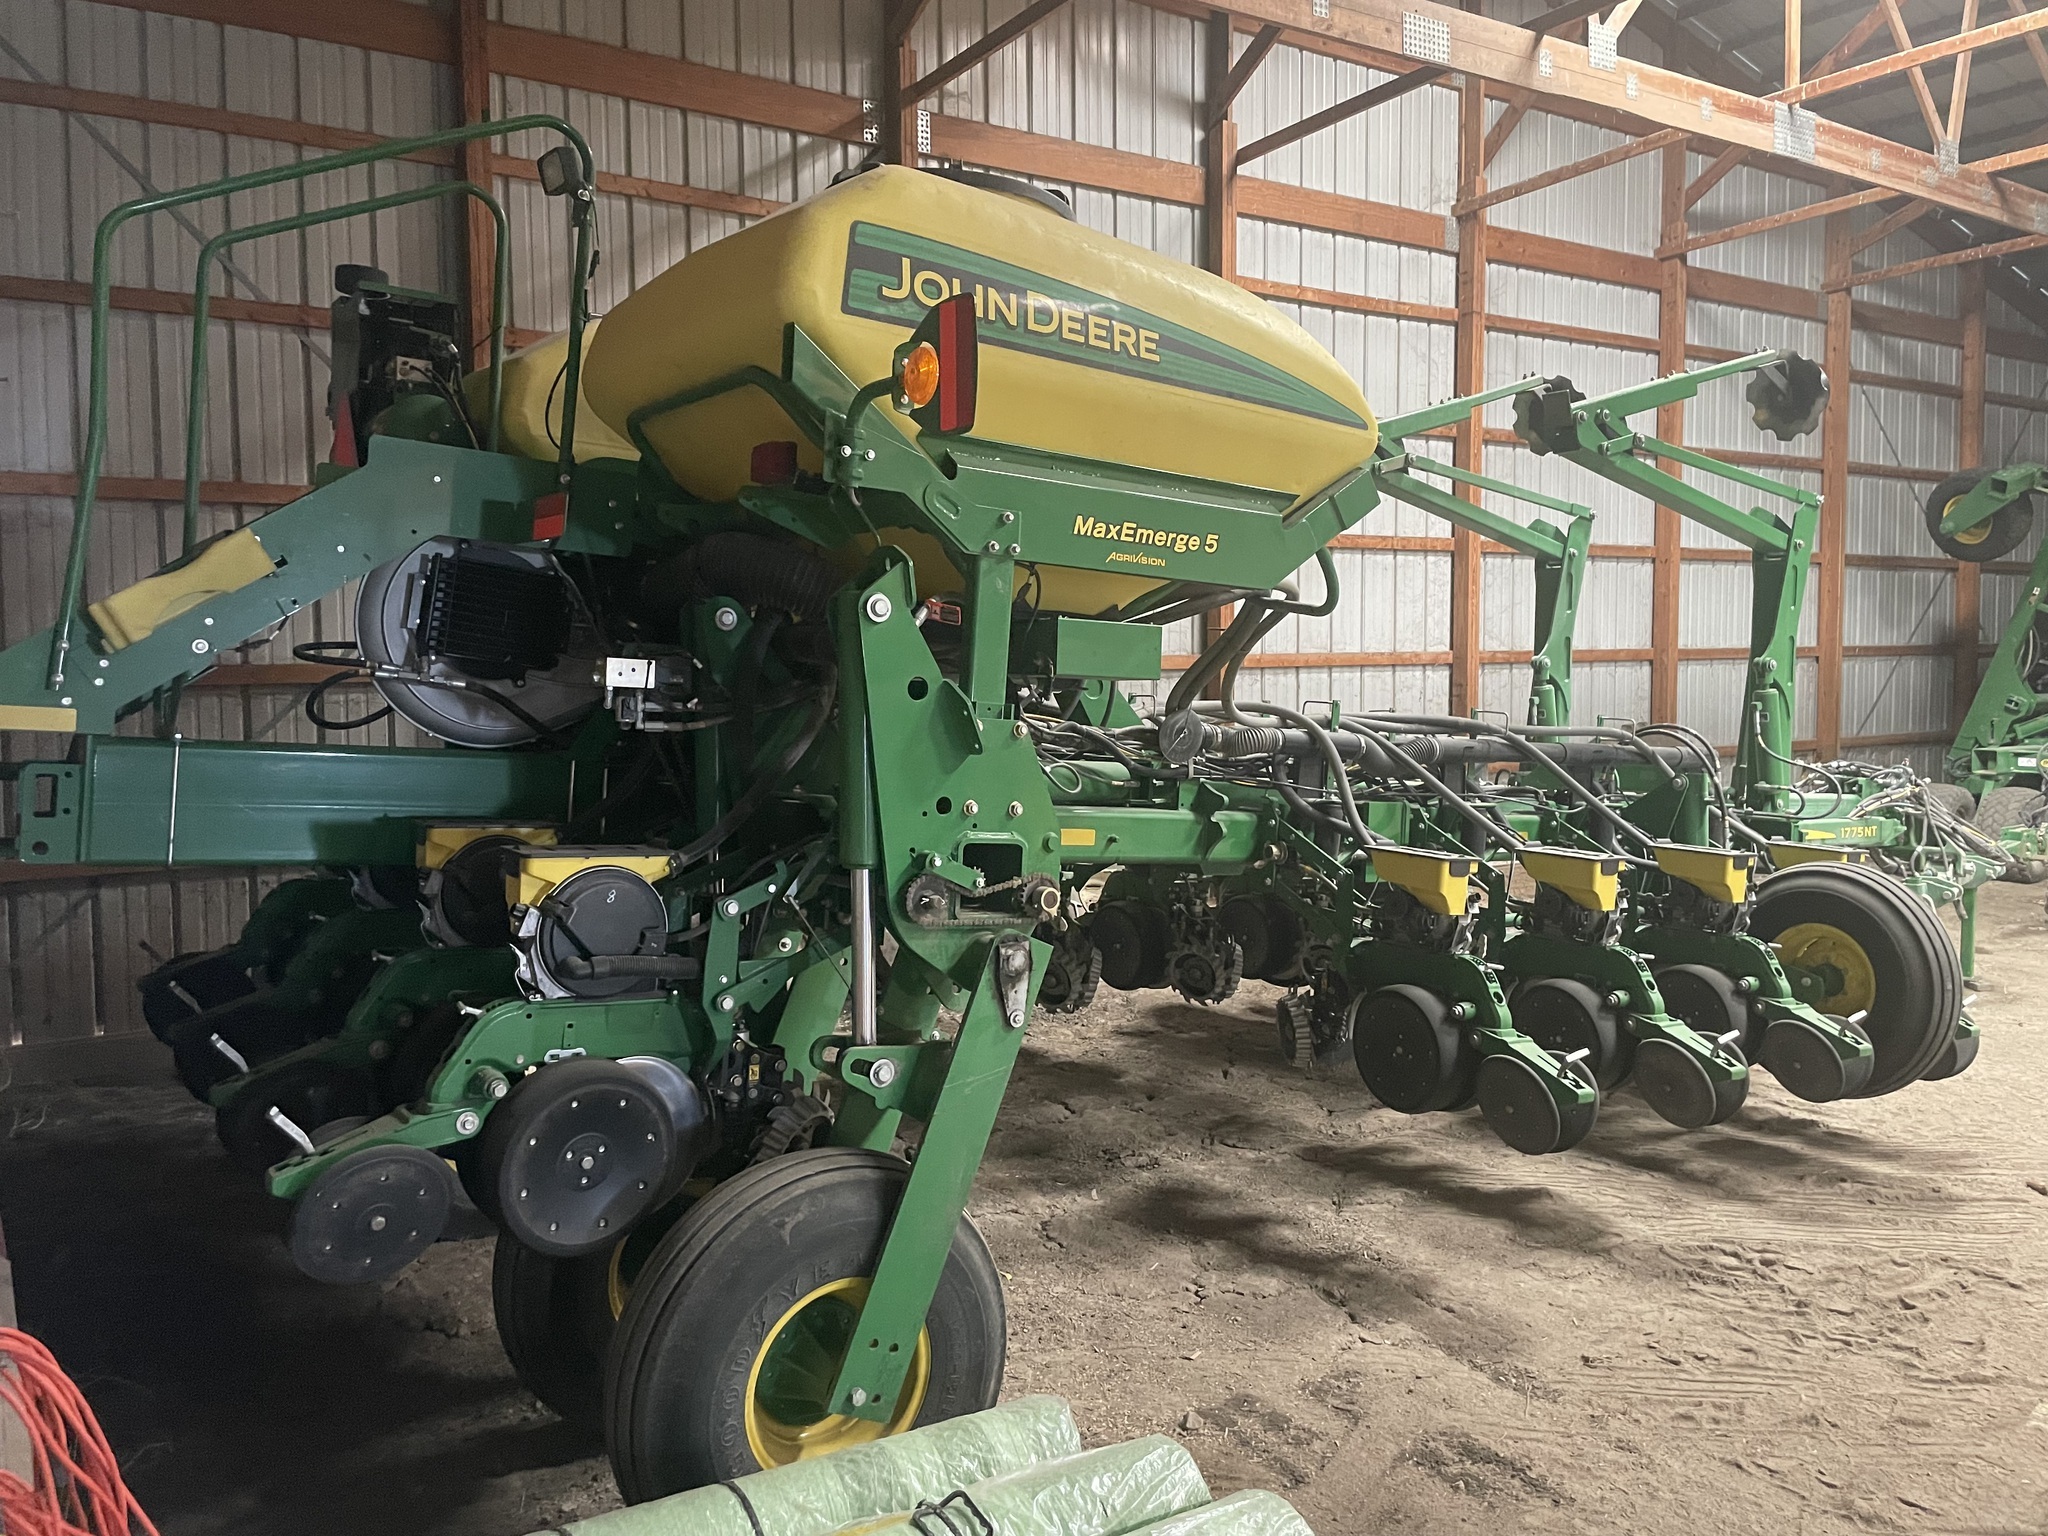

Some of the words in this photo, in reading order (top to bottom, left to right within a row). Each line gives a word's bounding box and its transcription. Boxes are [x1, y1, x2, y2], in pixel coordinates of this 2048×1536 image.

[1026, 289, 1161, 362] DEERE
[1072, 514, 1201, 553] MaxEmerge
[1204, 533, 1220, 554] 5
[1840, 825, 1878, 839] 1775NT
[606, 889, 616, 903] 8
[720, 1252, 866, 1477] GOODYEA
